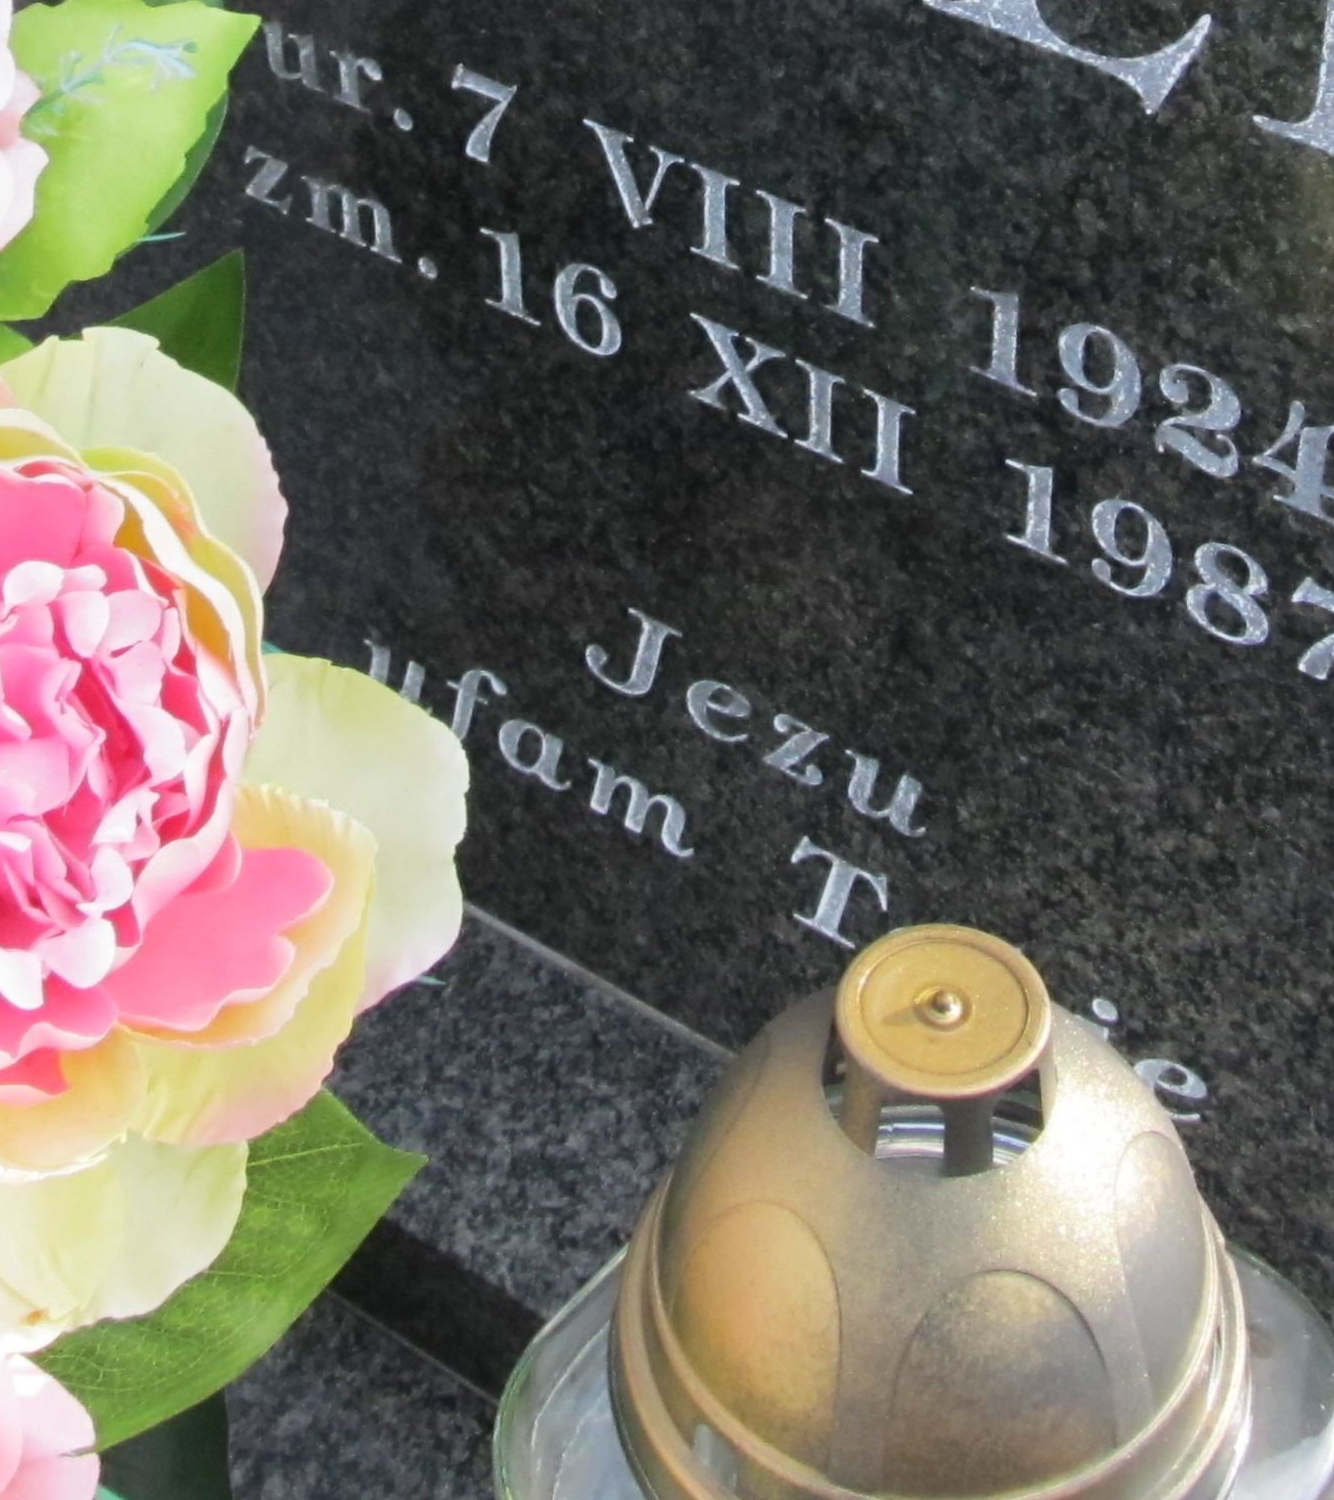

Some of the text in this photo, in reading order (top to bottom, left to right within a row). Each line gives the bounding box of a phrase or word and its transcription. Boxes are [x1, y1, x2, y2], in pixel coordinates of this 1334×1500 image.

[242, 143, 440, 282] zm.
[478, 226, 623, 358] 16
[688, 311, 917, 496] XII
[261, 19, 415, 133] ur.
[450, 61, 520, 165] 7
[582, 116, 880, 329] VIII
[584, 605, 929, 839] Jezu
